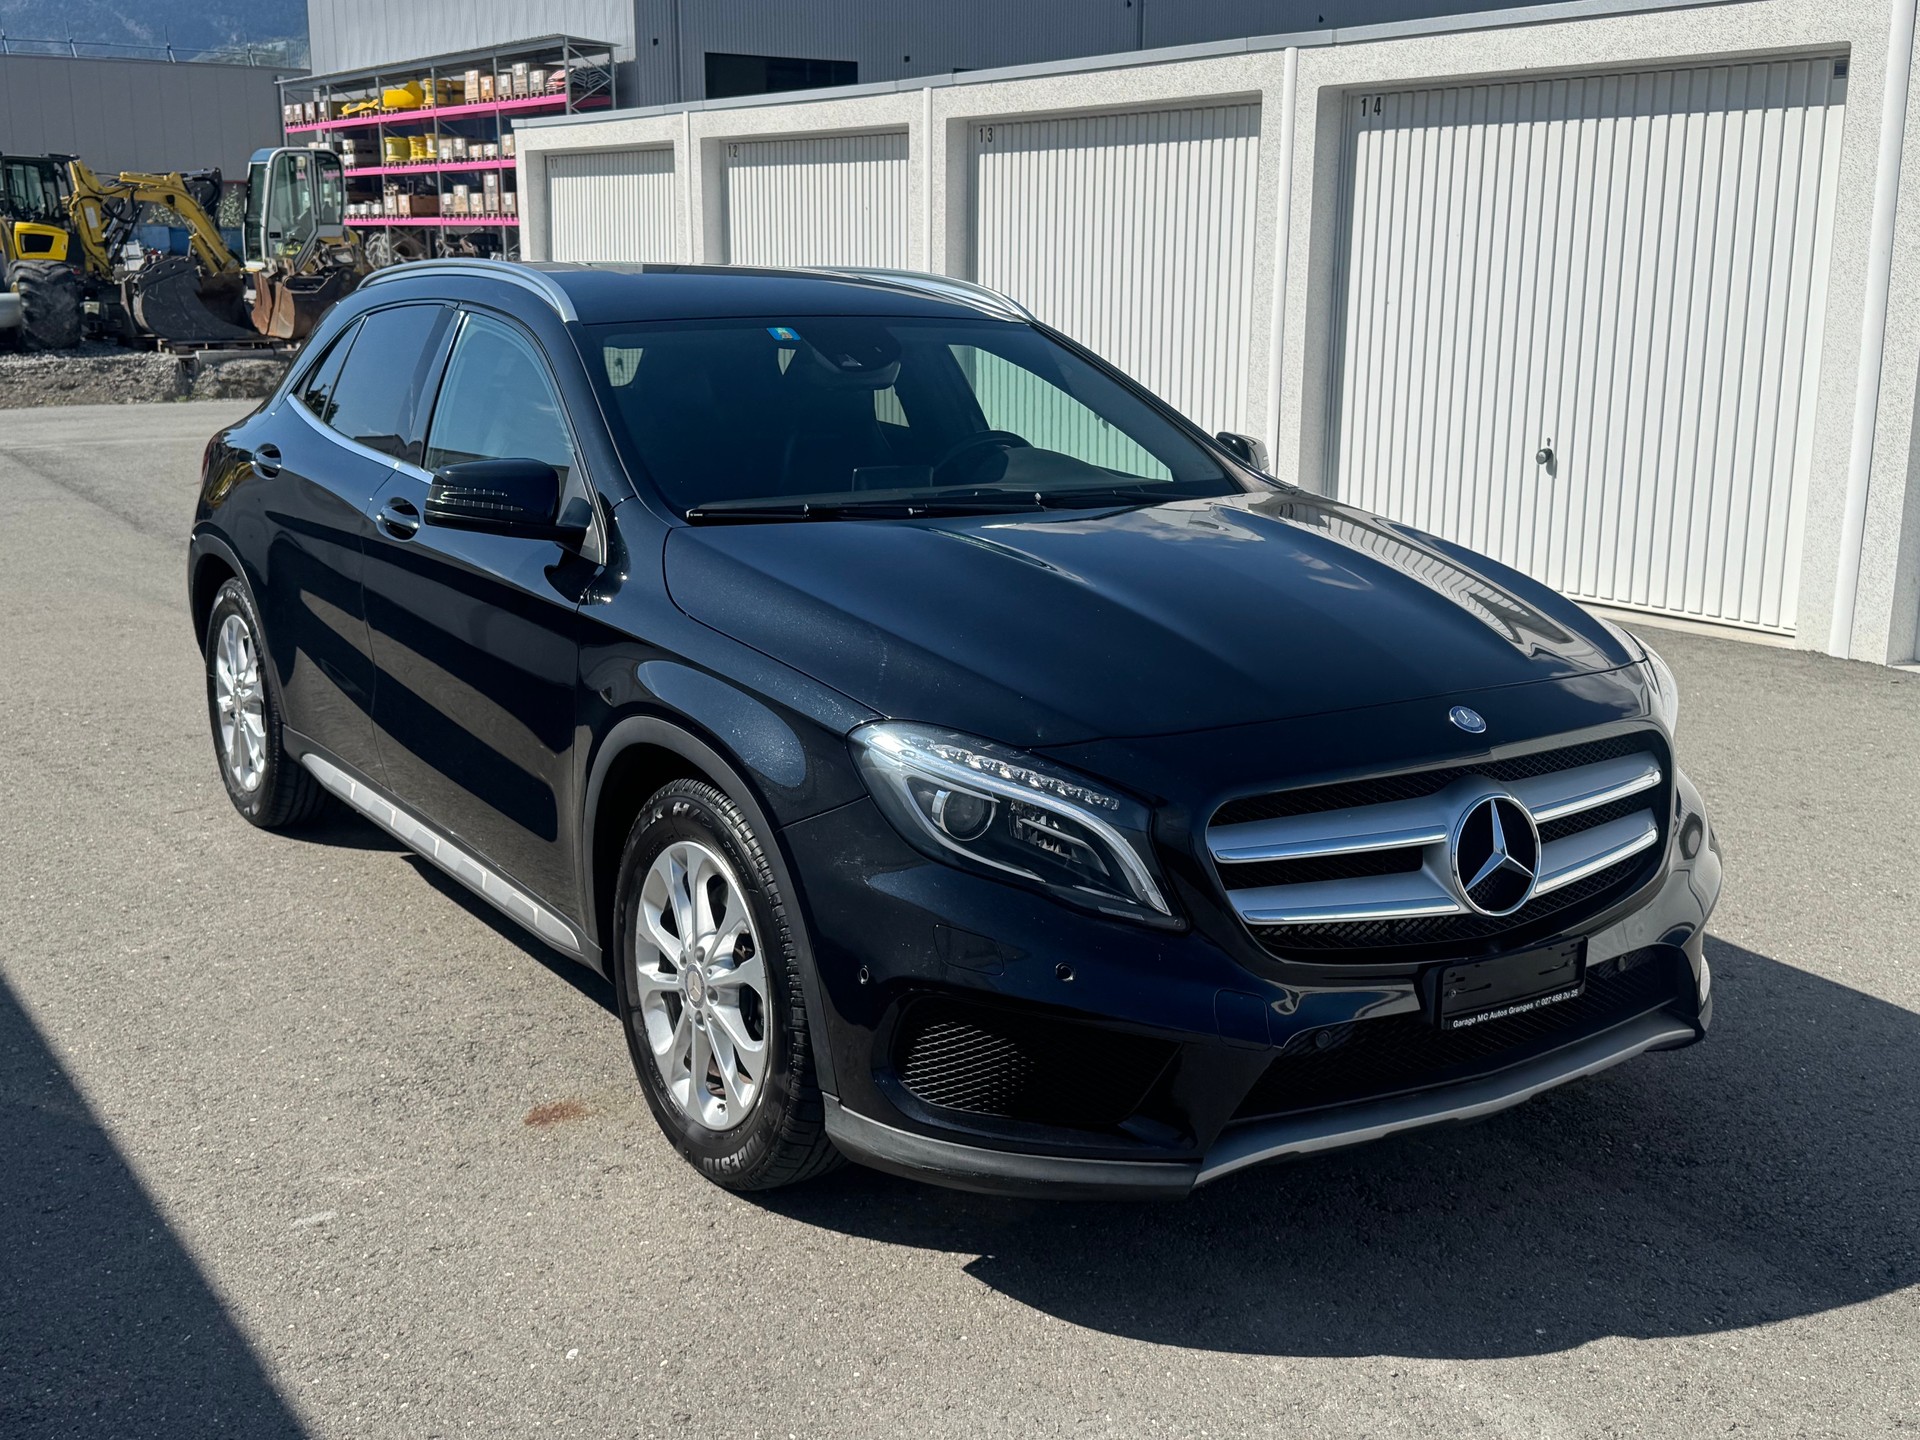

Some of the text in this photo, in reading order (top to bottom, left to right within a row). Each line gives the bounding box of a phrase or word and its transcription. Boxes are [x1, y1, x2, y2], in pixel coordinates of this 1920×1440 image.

[1361, 96, 1382, 117] 14
[979, 127, 993, 143] 13
[728, 144, 738, 158] 12
[1452, 1017, 1477, 1028] Garage
[1477, 1013, 1489, 1022] MC
[1489, 1010, 1508, 1019] Autos
[1508, 1003, 1534, 1014] Granges
